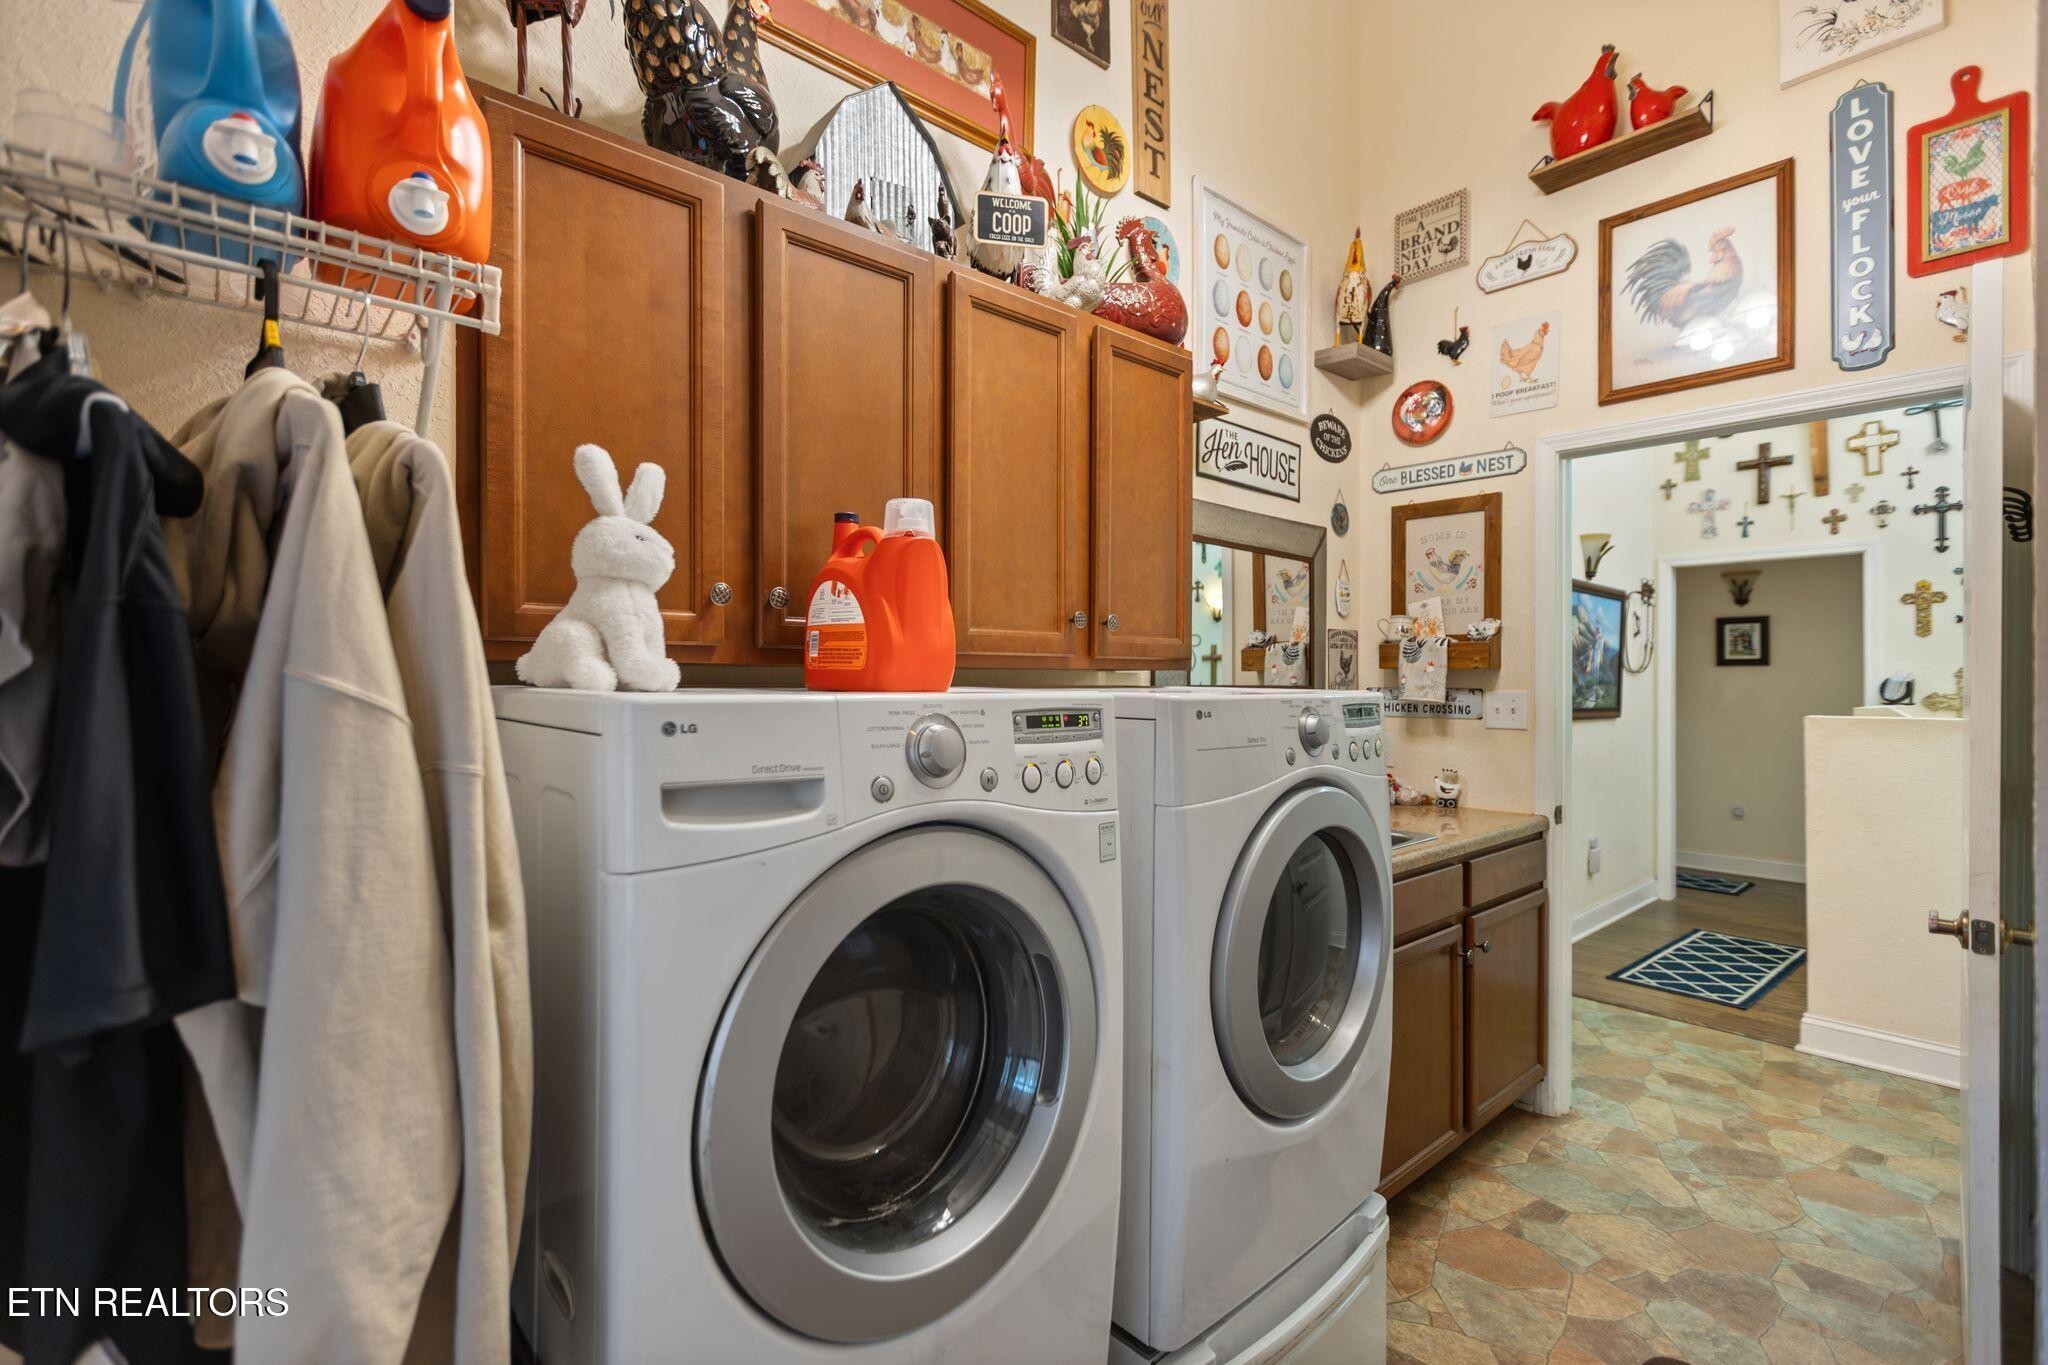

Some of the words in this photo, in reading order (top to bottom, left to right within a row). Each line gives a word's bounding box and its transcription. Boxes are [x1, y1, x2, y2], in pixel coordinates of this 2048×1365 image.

[1142, 28, 1165, 179] NEST
[1846, 97, 1875, 189] LOVE
[992, 197, 1032, 211] WELCOME
[1842, 189, 1881, 214] your
[992, 211, 1032, 235] COOP
[1401, 215, 1418, 226] TIME
[1420, 210, 1430, 219] TO
[1416, 220, 1425, 232] A
[1401, 220, 1460, 252] BRAND
[1401, 242, 1434, 263] NEW
[1401, 255, 1432, 275] DAY
[1848, 208, 1876, 327] FLOCK
[1495, 389, 1514, 398] POOP
[1515, 381, 1557, 396] BREAKFAST!
[1224, 429, 1239, 441] THE
[1318, 420, 1347, 439] BEWARE
[1315, 437, 1347, 458] CHICKENS
[1323, 433, 1331, 441] OF
[1331, 435, 1341, 445] THE
[1202, 429, 1243, 470] Hen
[1244, 442, 1296, 486] HOUSE
[1379, 474, 1398, 487] One
[1400, 464, 1456, 486] BLESSED
[1476, 454, 1514, 474] NEST
[1420, 530, 1453, 544] HOME
[1454, 530, 1467, 540] IS
[1203, 711, 1212, 719] LG
[1384, 702, 1419, 713] HICKEN
[1422, 703, 1472, 715] CROSSING
[680, 723, 698, 734] LG
[1078, 715, 1088, 726] 37
[752, 764, 779, 774] Direct
[779, 763, 802, 773] Drive
